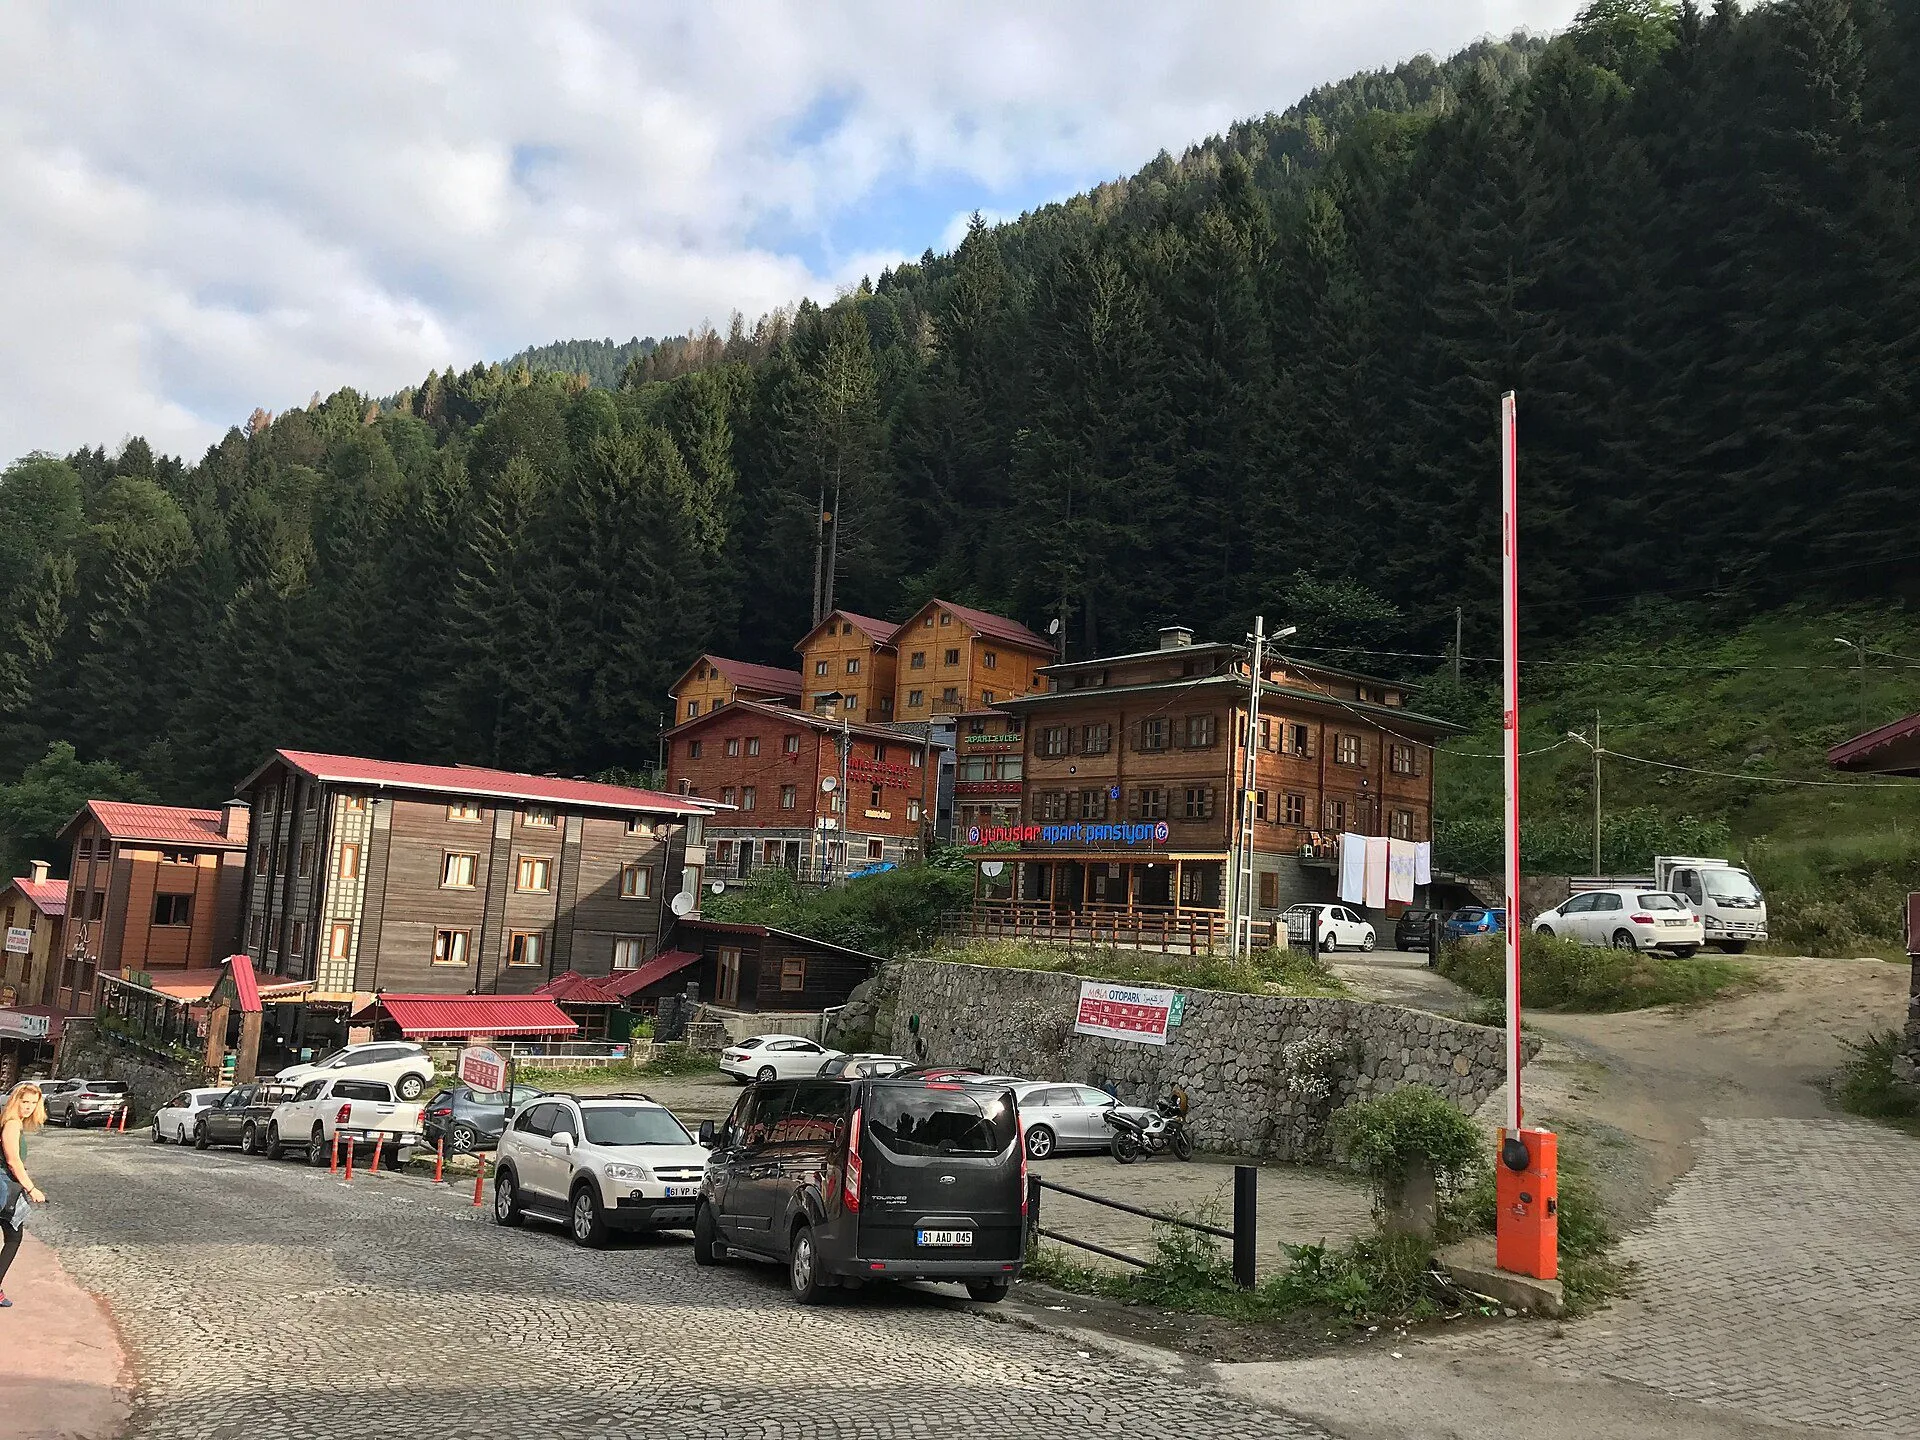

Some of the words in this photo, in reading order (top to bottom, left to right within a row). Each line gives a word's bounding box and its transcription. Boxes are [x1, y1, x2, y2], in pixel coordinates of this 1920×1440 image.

[966, 735, 991, 743] APART
[995, 733, 1018, 742] EVLER
[980, 825, 1041, 846] yunuslar
[1043, 823, 1082, 844] apart
[1086, 821, 1155, 845] pansiyon
[1108, 989, 1140, 1003] OTOPARK
[670, 1188, 678, 1196] 61
[681, 1188, 690, 1196] VP
[692, 1187, 700, 1195] 6
[923, 1232, 932, 1243] 61
[935, 1232, 952, 1243] AAD
[955, 1232, 971, 1243] 045
